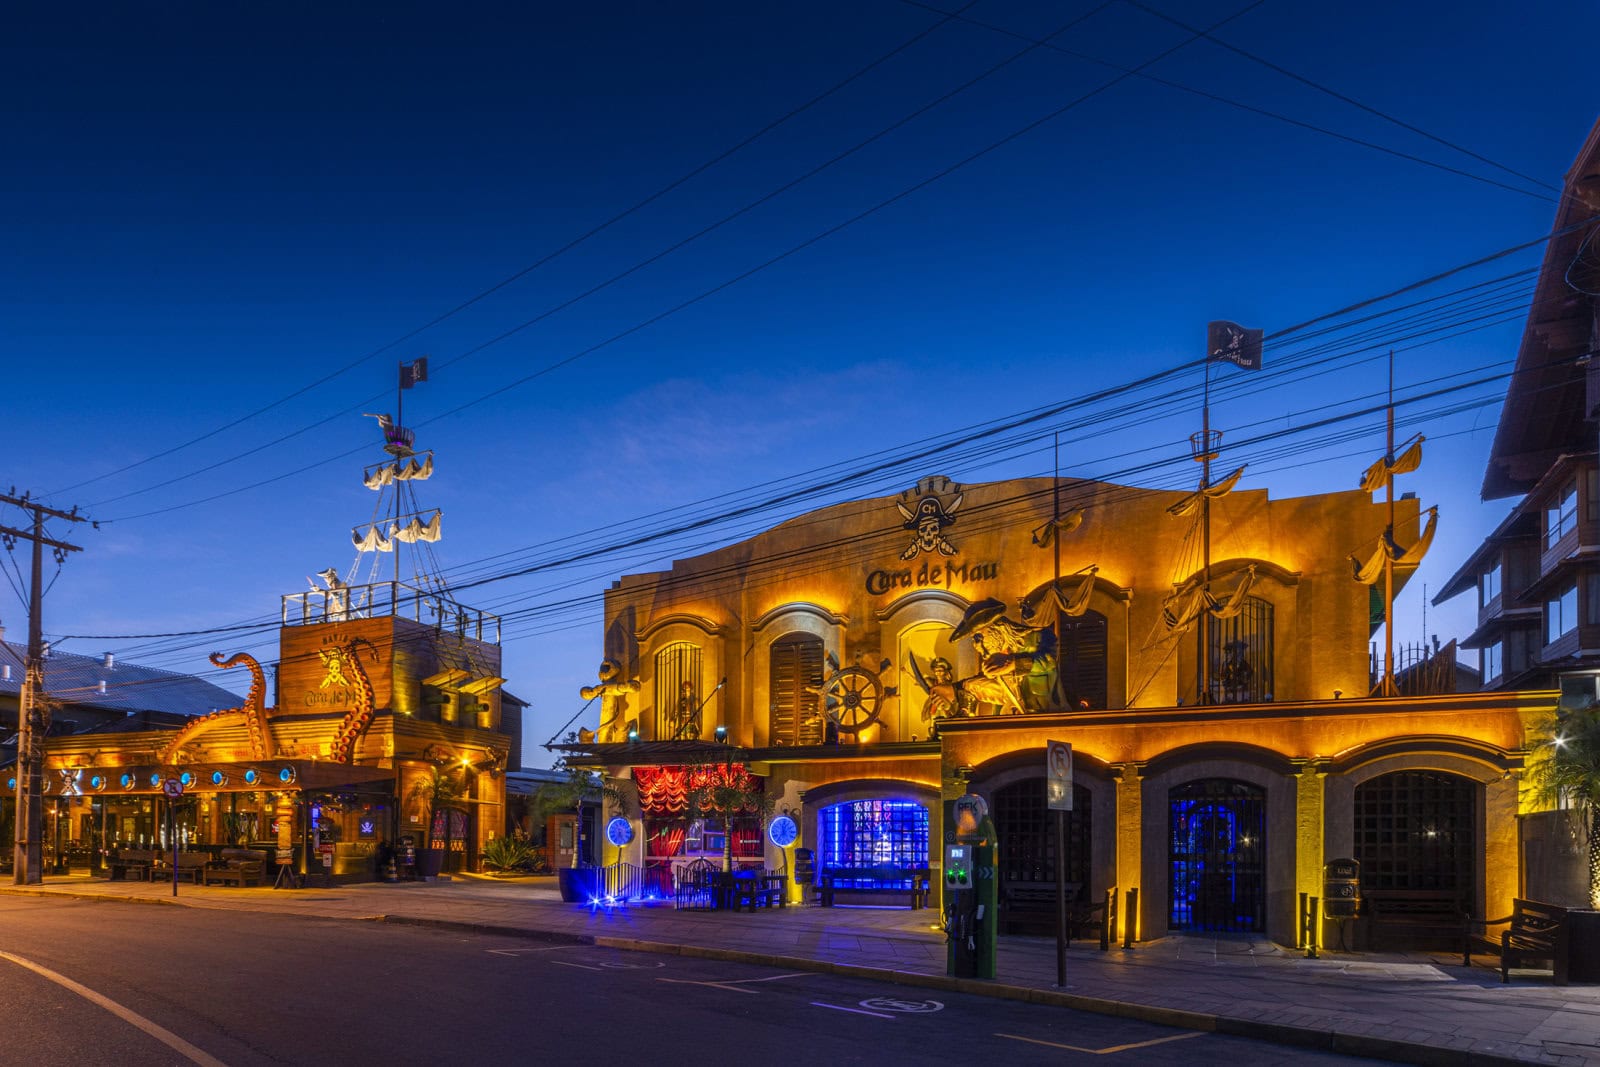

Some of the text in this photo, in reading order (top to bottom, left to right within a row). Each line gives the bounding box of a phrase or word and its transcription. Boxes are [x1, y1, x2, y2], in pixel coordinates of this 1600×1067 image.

[865, 559, 998, 596] Cara de Mau
